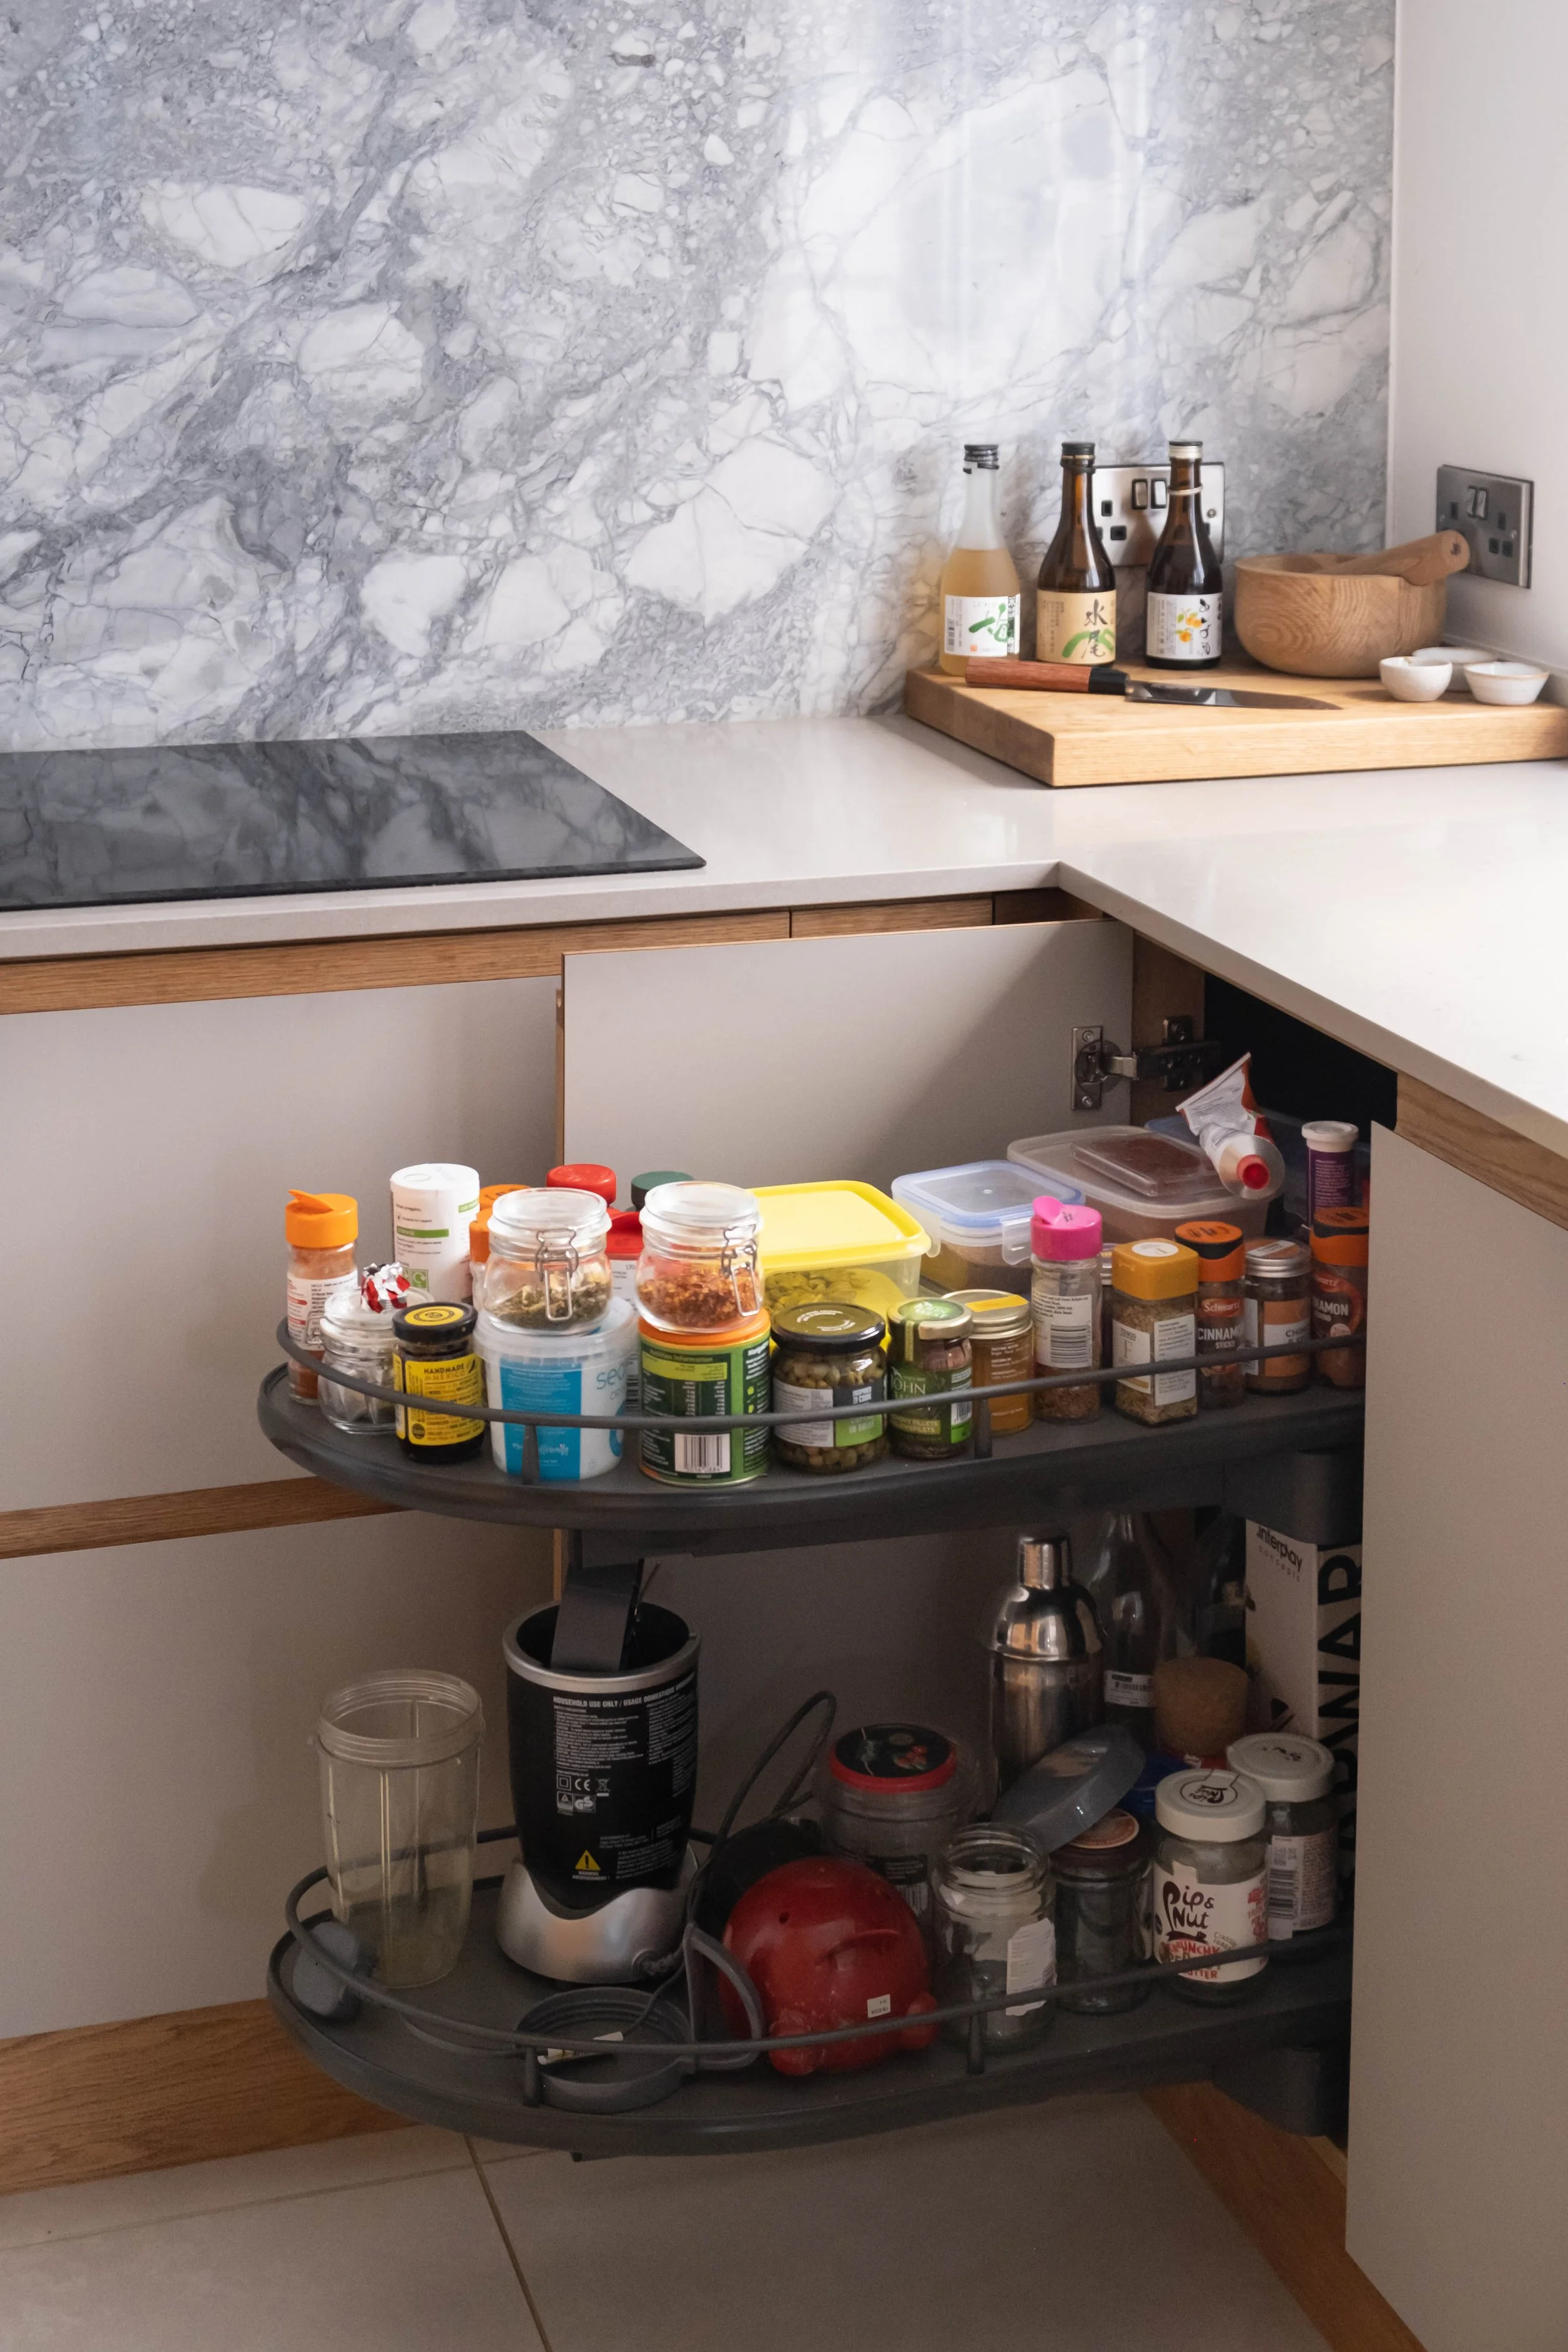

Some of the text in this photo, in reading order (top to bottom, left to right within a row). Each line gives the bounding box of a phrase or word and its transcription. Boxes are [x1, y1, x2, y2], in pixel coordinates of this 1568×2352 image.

[1081, 598, 1108, 659] 水尾
[1203, 1301, 1241, 1312] Schwartz
[1313, 1295, 1349, 1316] NAMON
[1197, 1325, 1242, 1340] CINNAM
[1286, 1325, 1310, 1337] CHIN
[1215, 1340, 1236, 1349] STICKS
[424, 1363, 465, 1374] HANDMADE
[1257, 1525, 1302, 1572] interplay
[553, 1696, 588, 1708] HOUSEHOLD
[623, 1697, 642, 1707] USAGE
[575, 1778, 590, 1791] CE
[575, 1796, 593, 1810] GS
[1163, 1881, 1215, 1932] Pip &
[1172, 1906, 1209, 1930] Nut
[1187, 1969, 1219, 1979] UTTER
